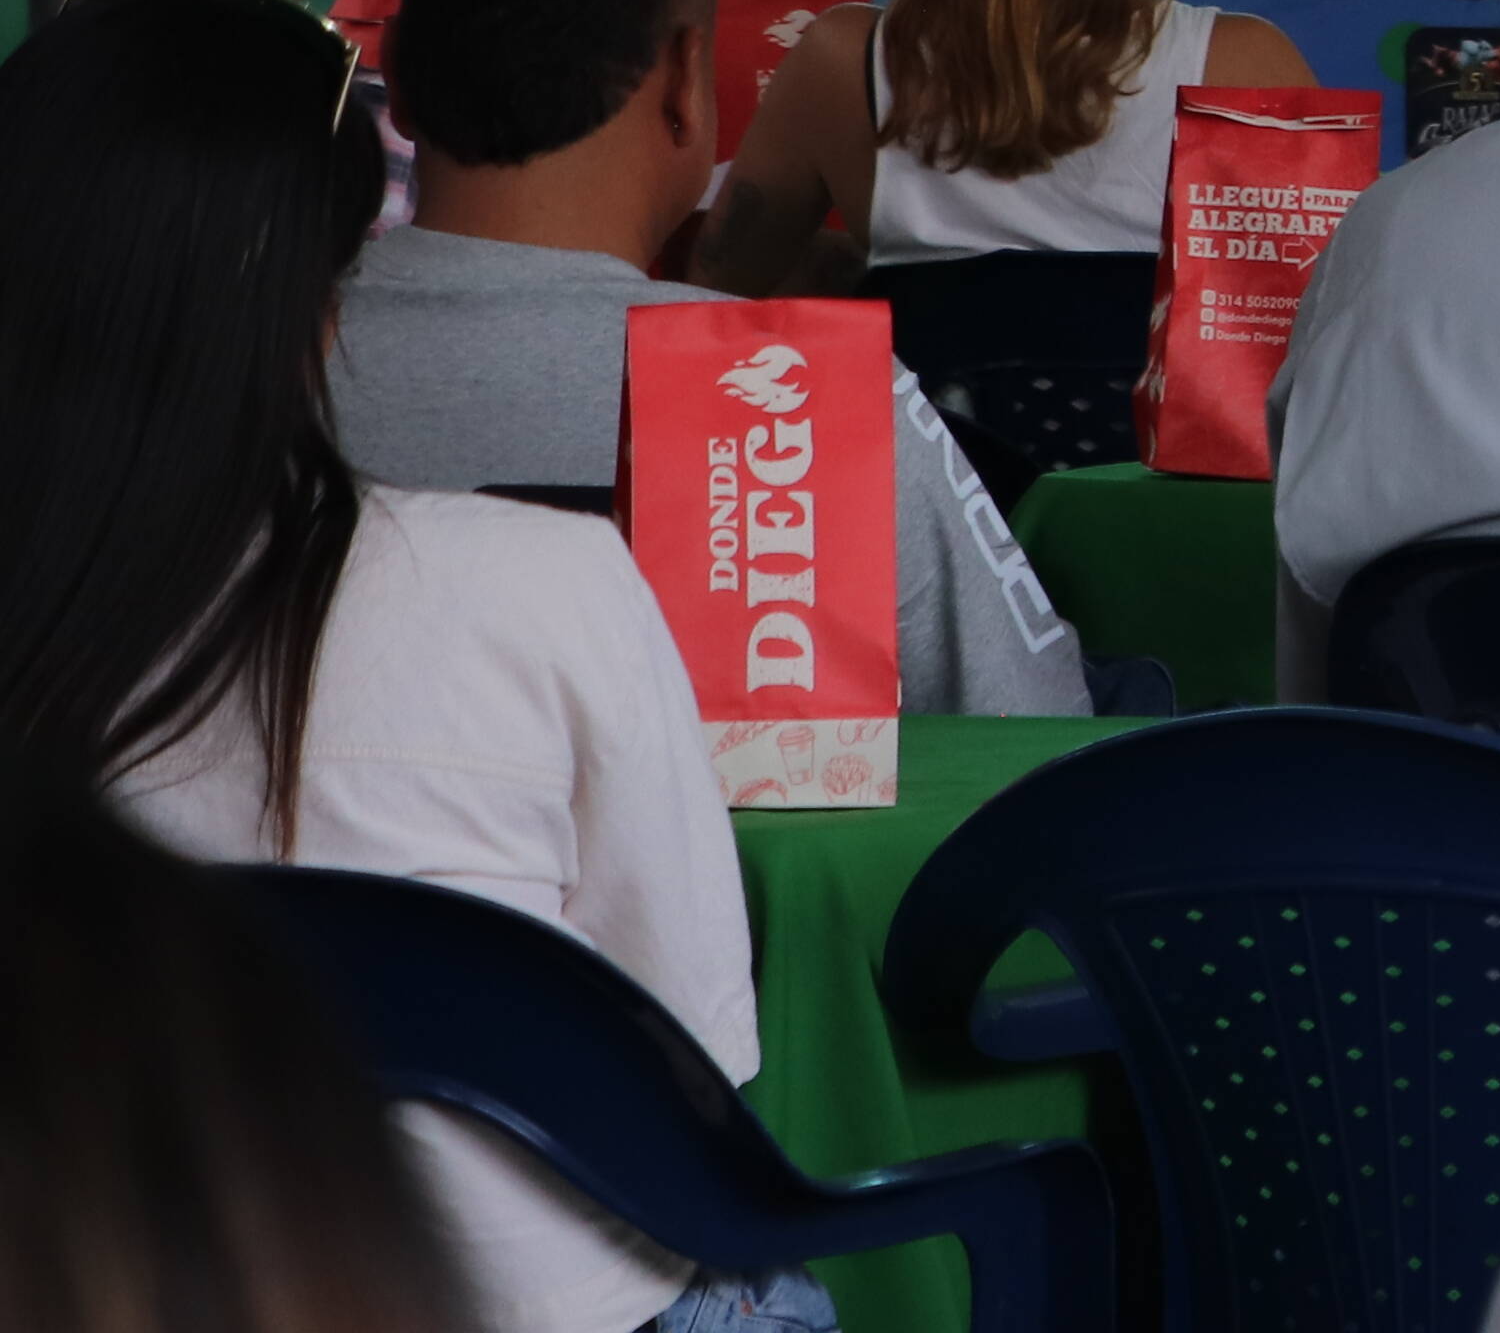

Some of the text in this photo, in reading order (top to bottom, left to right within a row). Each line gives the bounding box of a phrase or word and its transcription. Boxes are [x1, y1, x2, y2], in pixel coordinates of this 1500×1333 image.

[1188, 184, 1300, 210] LLEGUÉ
[1188, 209, 1343, 237] ALEGRART
[1187, 234, 1279, 262] EL DÍA
[1217, 294, 1242, 306] 314
[1254, 332, 1287, 345] Diego
[709, 437, 740, 593] DONDE
